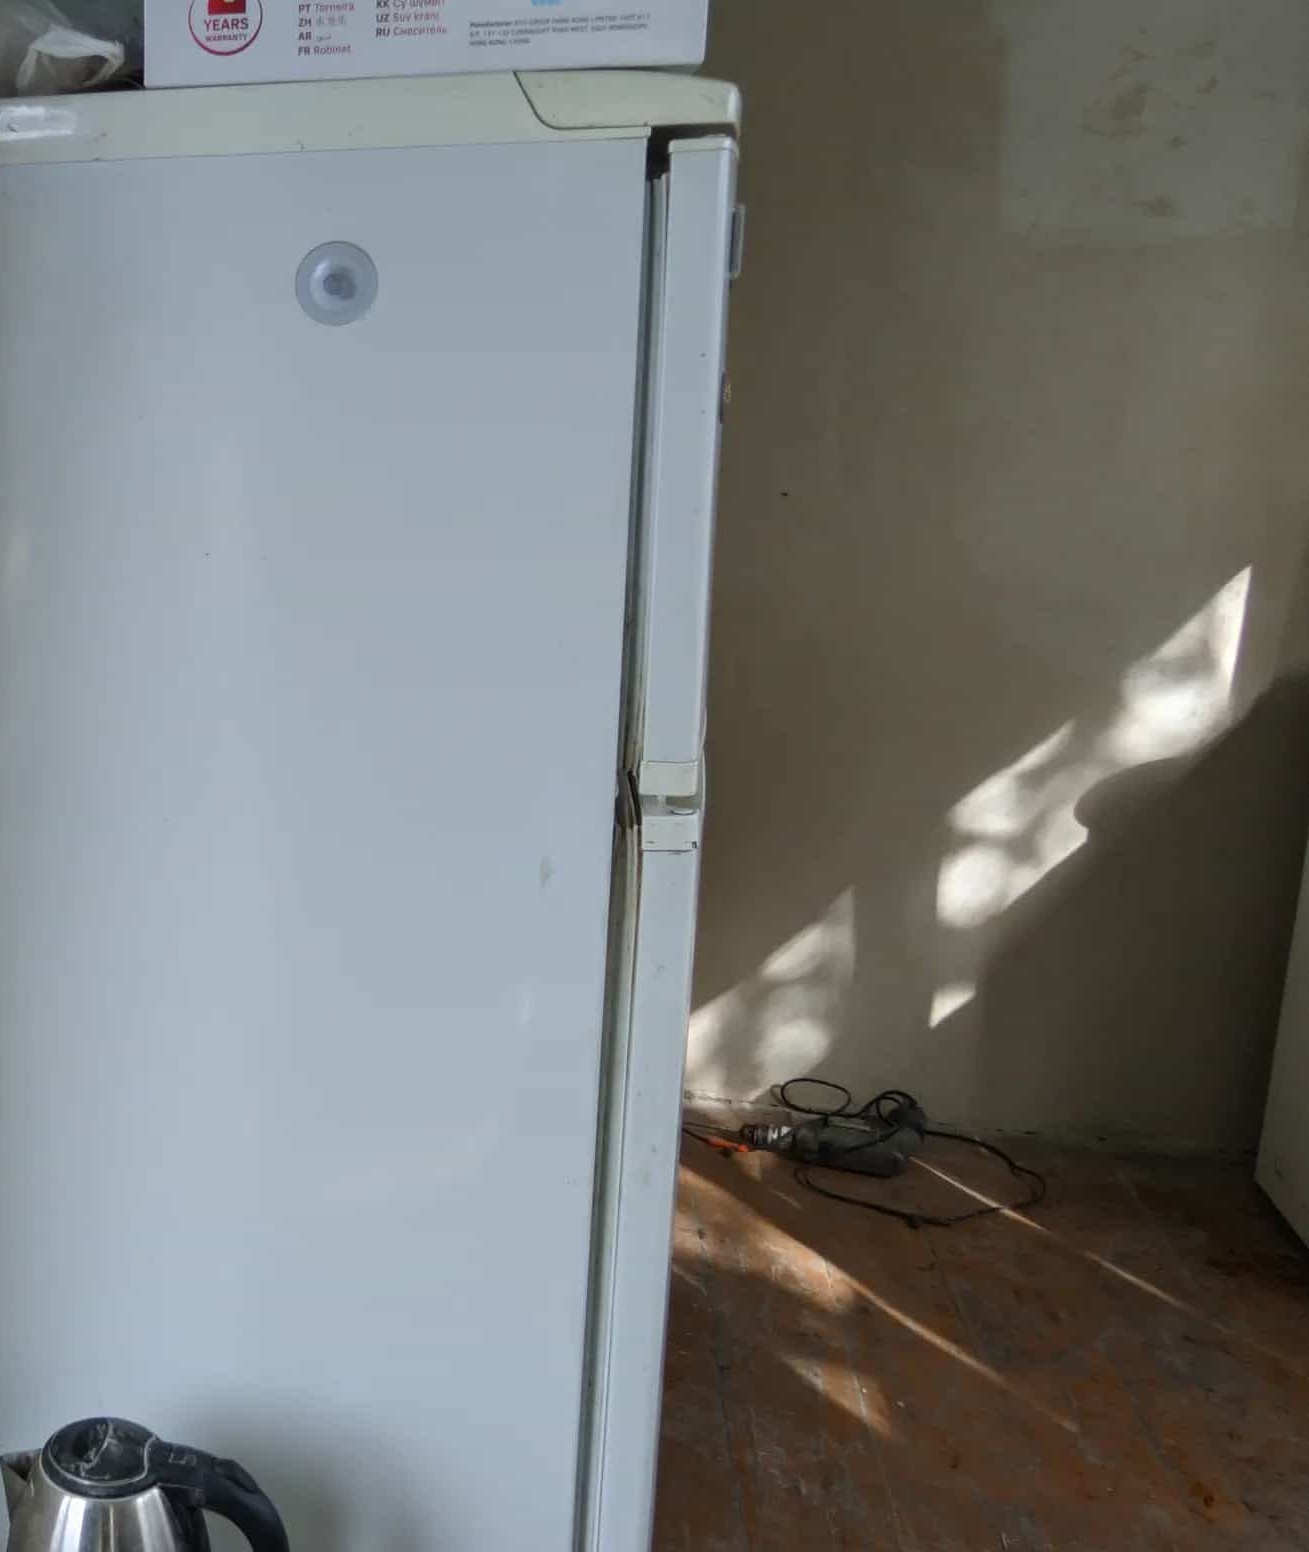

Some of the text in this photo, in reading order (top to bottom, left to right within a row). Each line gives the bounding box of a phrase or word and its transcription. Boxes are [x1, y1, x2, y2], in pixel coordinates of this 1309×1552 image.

[299, 4, 311, 13] PT
[376, 0, 390, 9] KK
[299, 18, 311, 28] ZH
[376, 13, 390, 23] UZ
[204, 17, 249, 32] YEARS
[298, 31, 312, 41] AR
[376, 27, 390, 38] RU
[298, 45, 351, 56] FR Robinet
